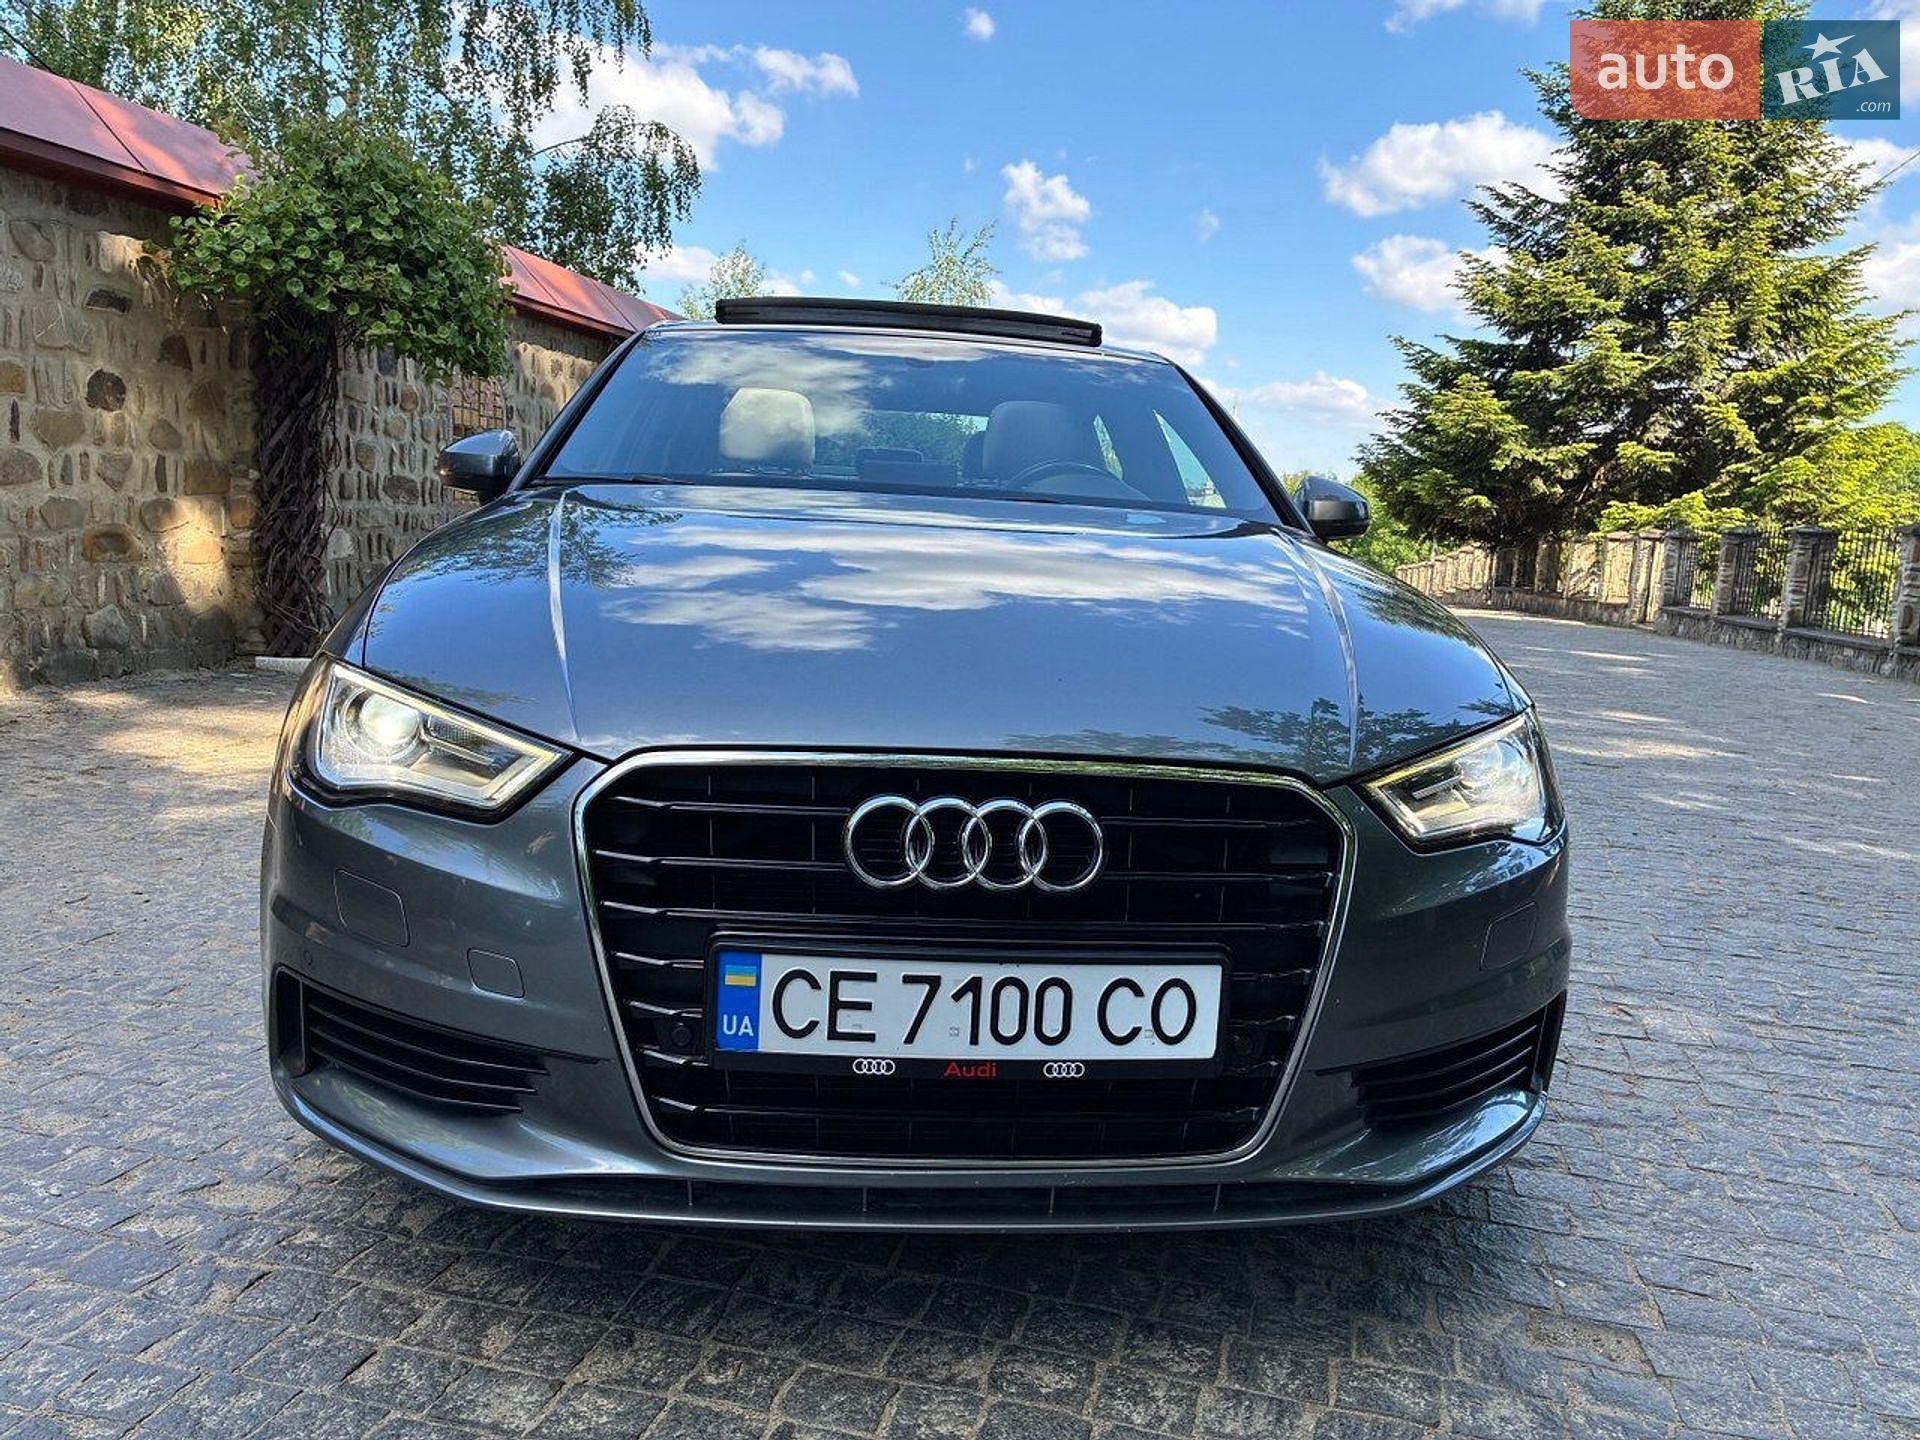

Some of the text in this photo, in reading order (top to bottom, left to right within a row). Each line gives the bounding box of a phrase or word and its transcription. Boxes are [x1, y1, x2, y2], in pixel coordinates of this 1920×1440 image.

[771, 968, 1197, 1046] CE 7100 CO
[723, 1014, 754, 1037] UA
[943, 1061, 997, 1078] Audi
